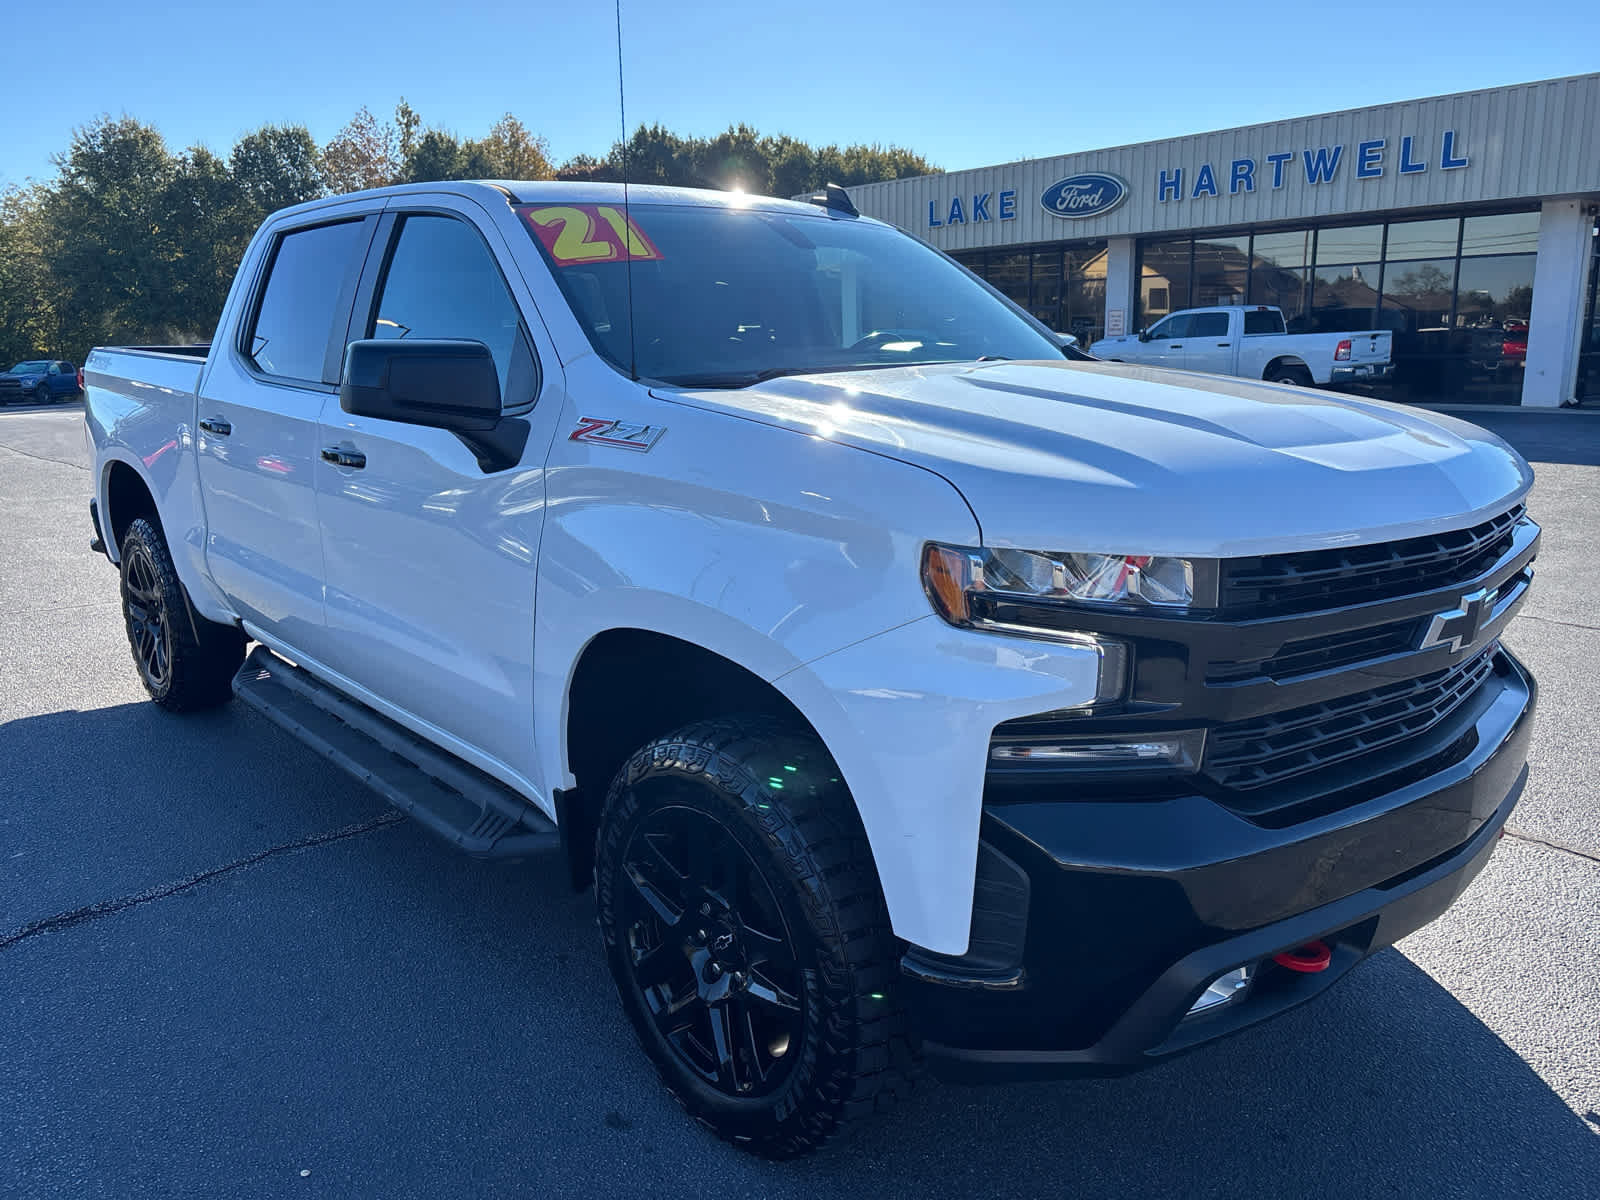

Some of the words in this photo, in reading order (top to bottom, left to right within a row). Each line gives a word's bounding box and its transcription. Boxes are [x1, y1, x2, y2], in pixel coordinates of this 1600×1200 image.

[928, 189, 1017, 228] LAKE
[1056, 183, 1103, 210] Ford
[1158, 129, 1469, 202] HARTWELL
[529, 206, 656, 261] 21
[568, 416, 668, 453] Z71
